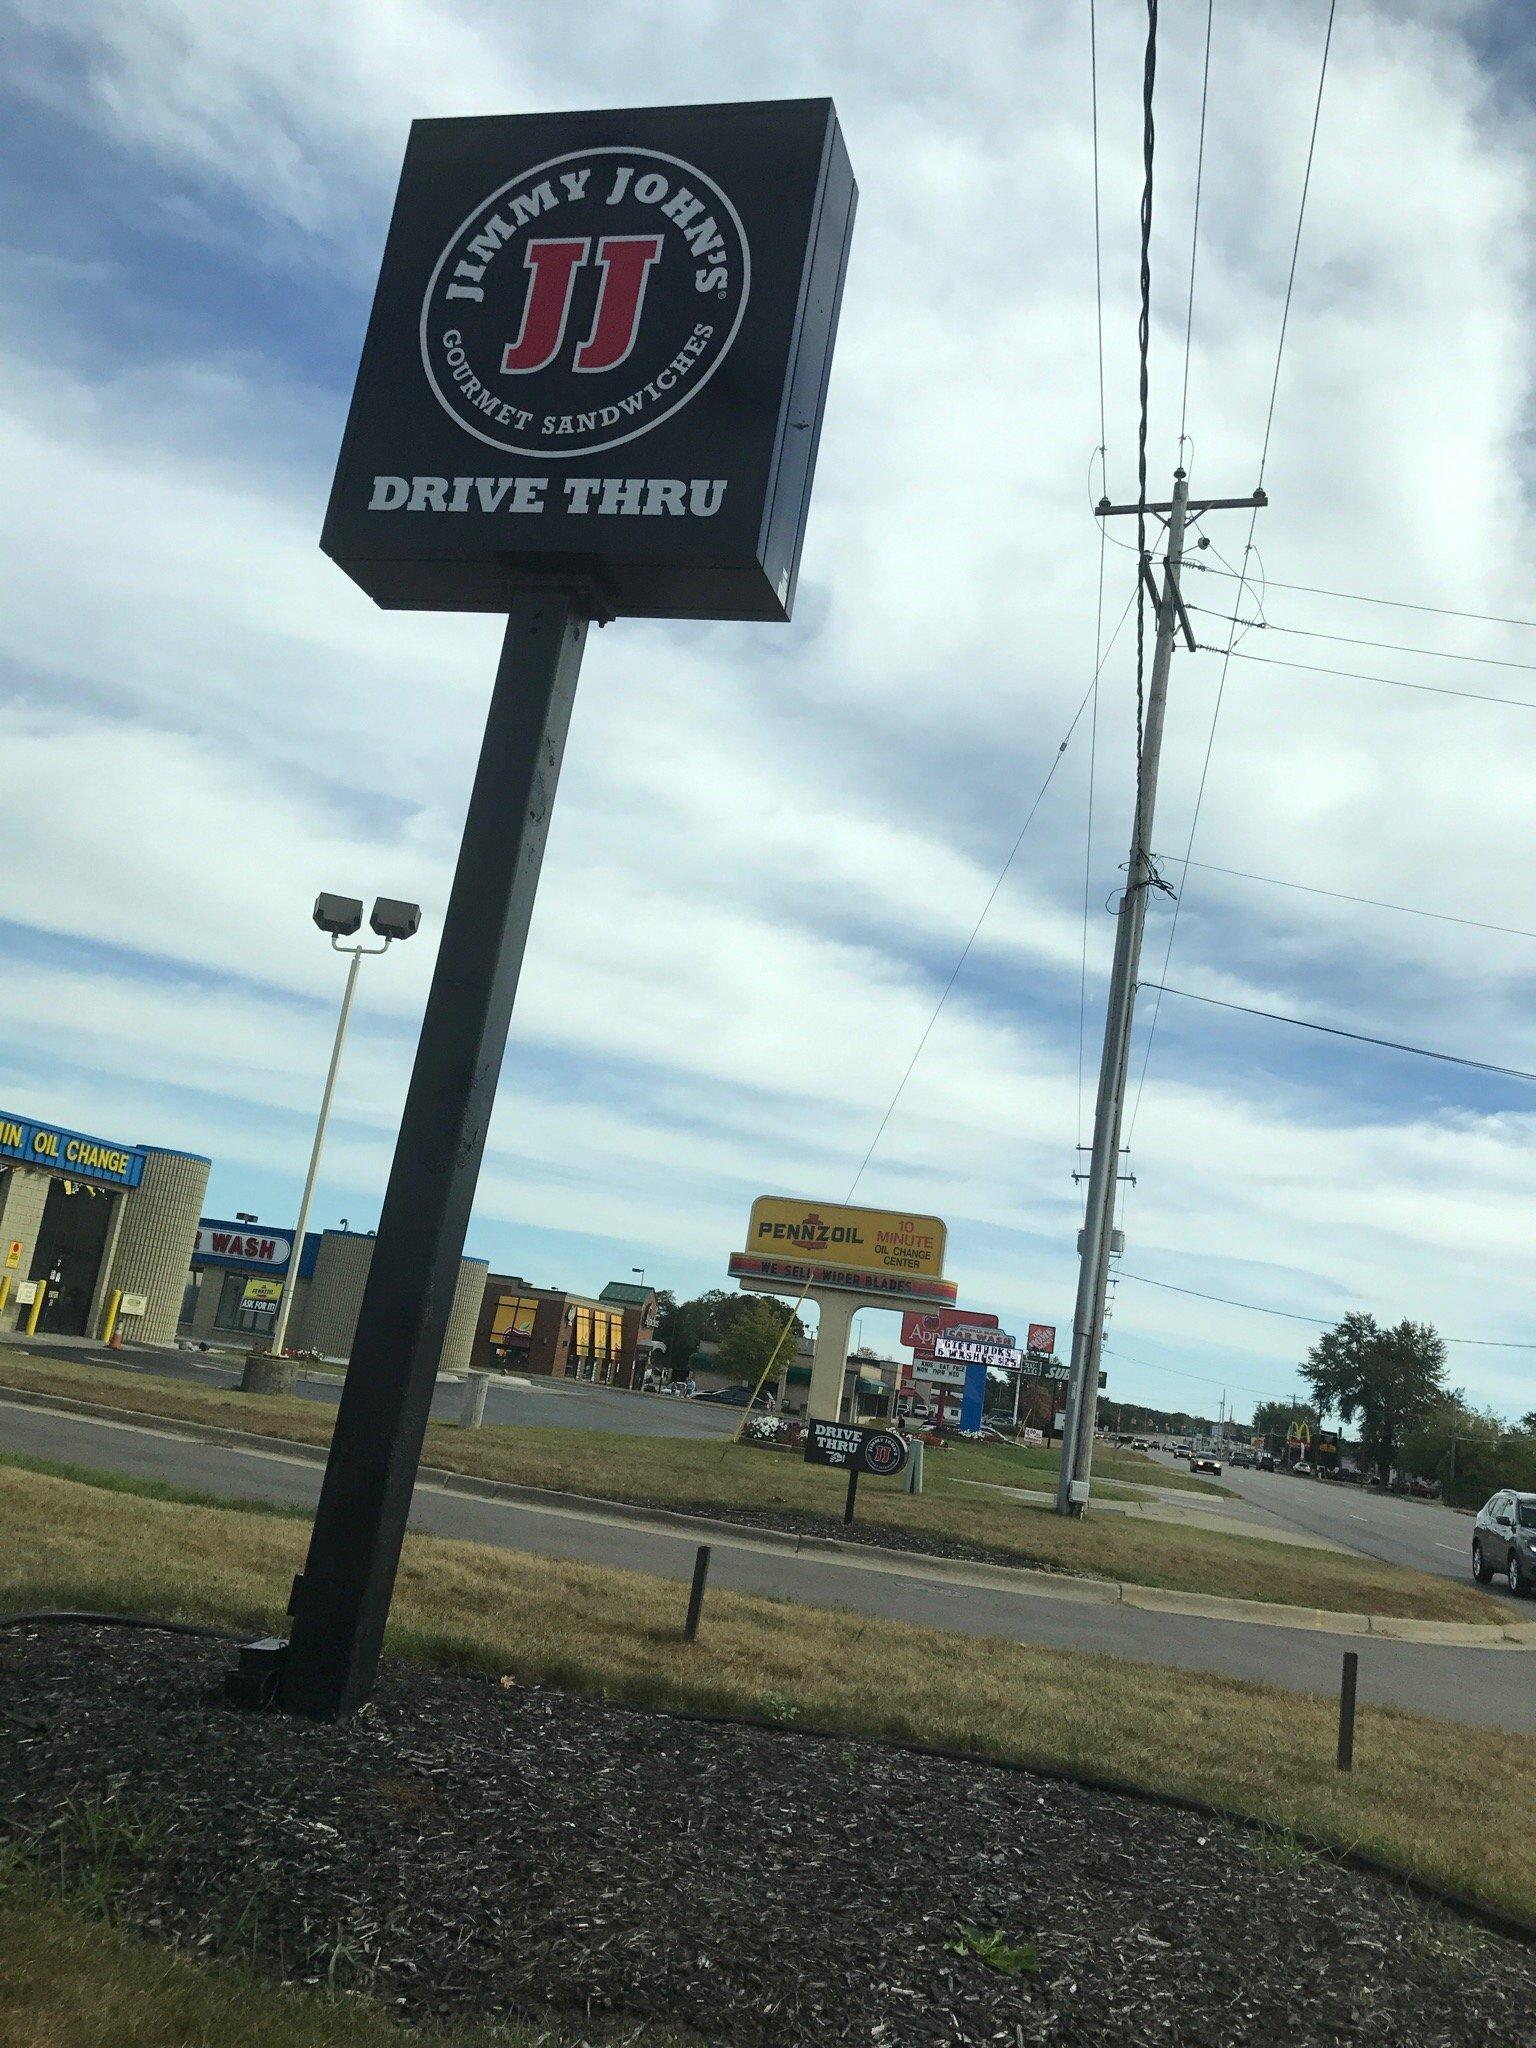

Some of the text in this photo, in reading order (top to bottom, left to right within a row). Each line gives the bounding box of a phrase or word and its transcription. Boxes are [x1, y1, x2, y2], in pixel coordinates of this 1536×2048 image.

[446, 167, 728, 302] JIMMY JOHN'S
[500, 234, 664, 374] JJ
[442, 323, 714, 435] GOURMET SANDWICHES
[368, 475, 727, 517] DRIVE THRU
[34, 1132, 59, 1157] OIL
[67, 1140, 130, 1175] CHANGE
[758, 1222, 864, 1244] PENNZOIL
[899, 1221, 914, 1233] 10
[212, 1232, 276, 1259] WASH
[877, 1231, 934, 1249] MINUTE
[874, 1244, 931, 1260] OIL CHANGE
[883, 1257, 920, 1268] CENTER
[761, 1261, 912, 1293] WE SELL WIPER BLADES
[242, 1299, 255, 1309] ASK
[255, 1301, 267, 1311] FOR
[815, 1424, 862, 1442] DRIVE
[817, 1436, 858, 1453] THRU
